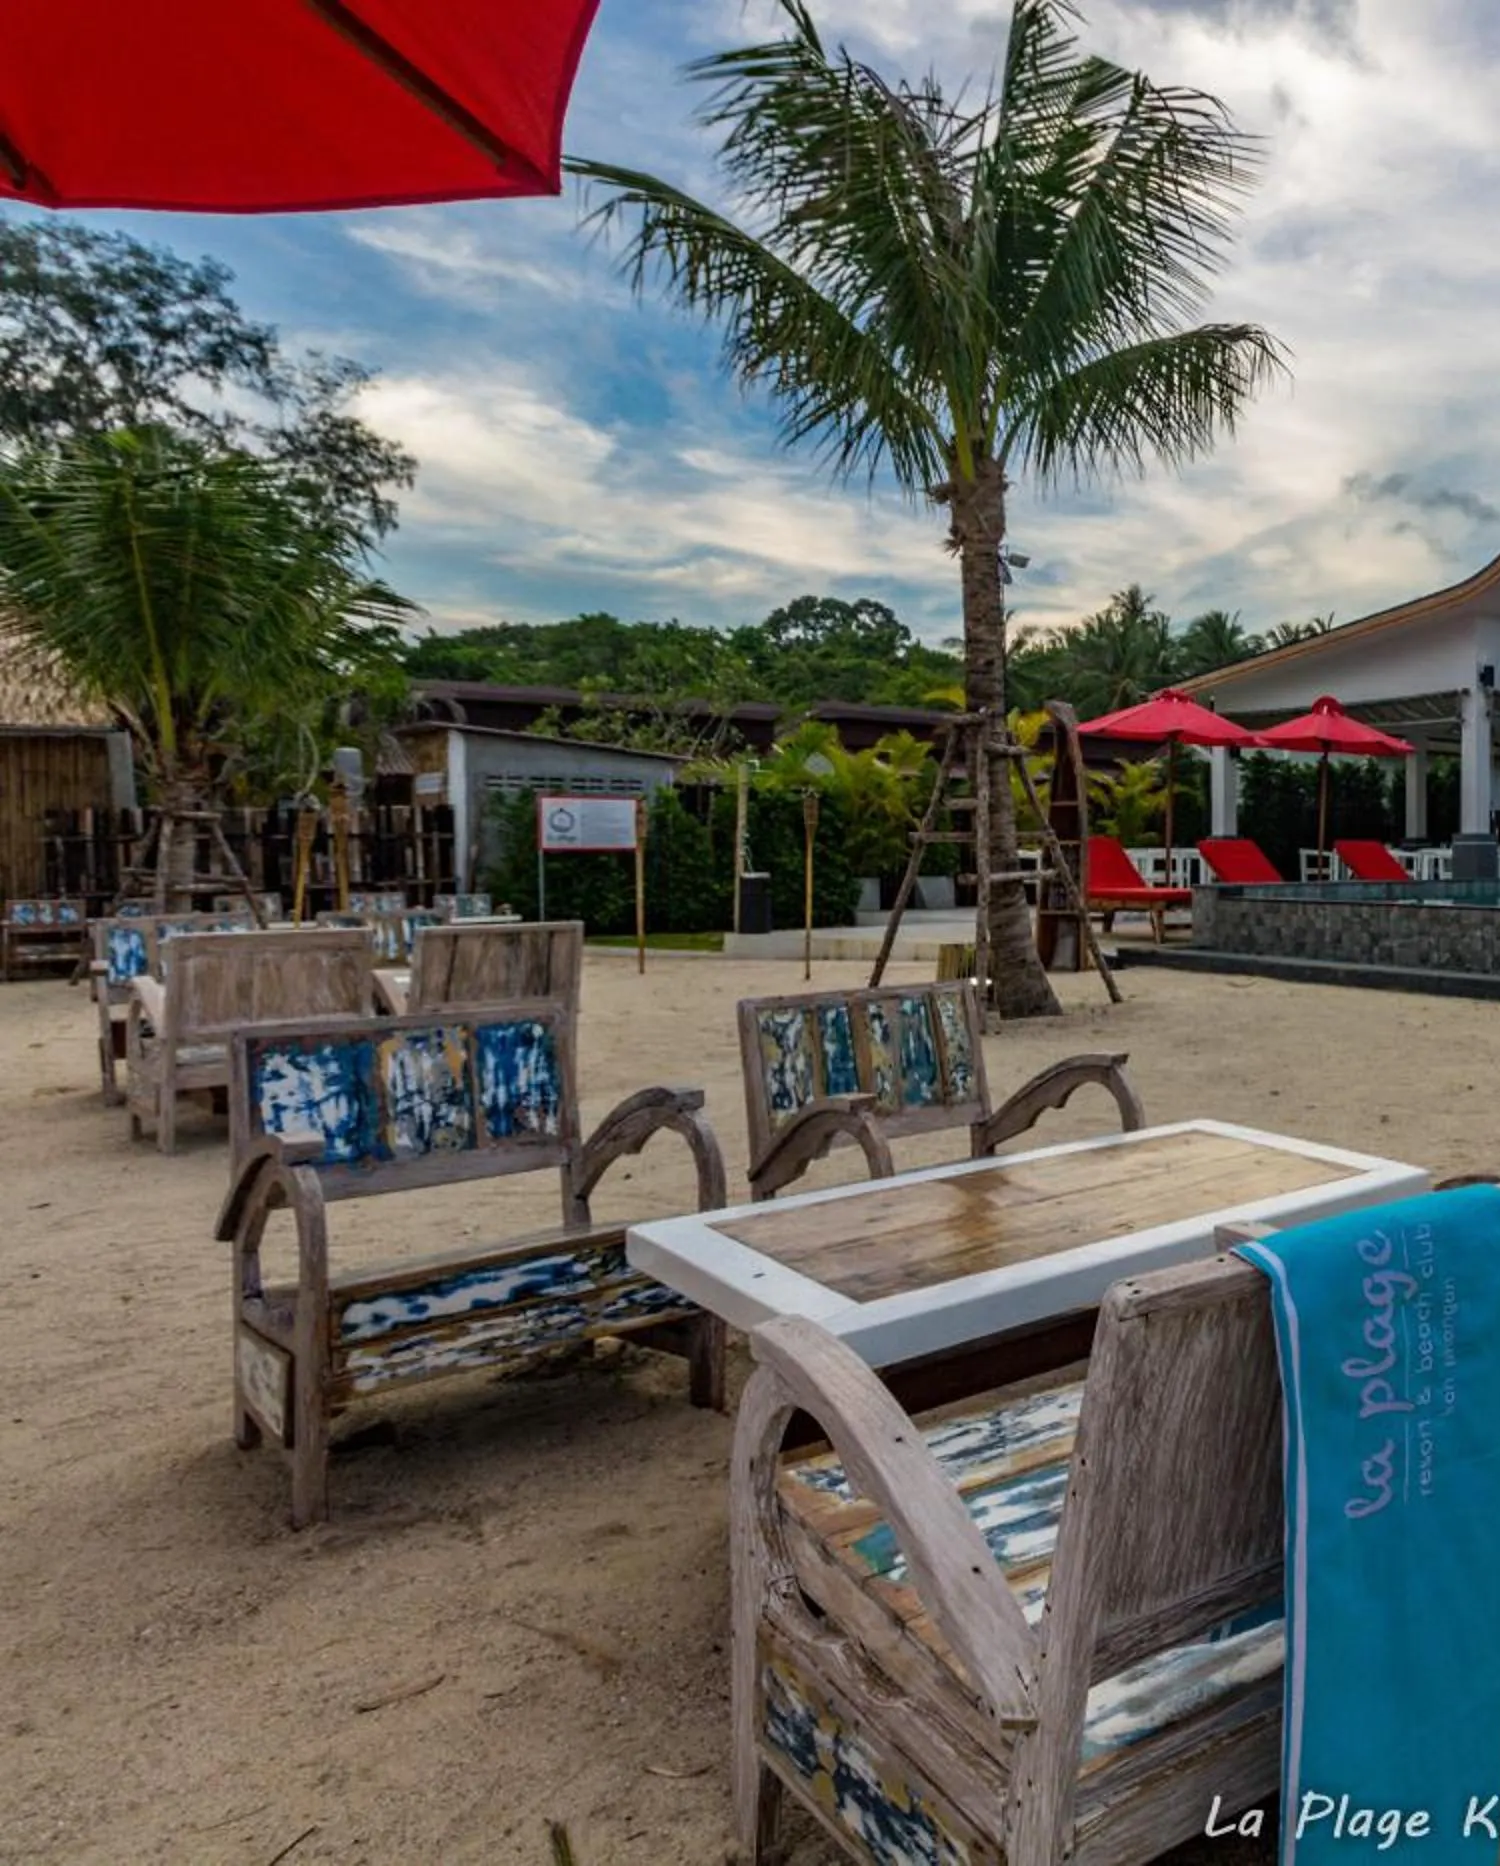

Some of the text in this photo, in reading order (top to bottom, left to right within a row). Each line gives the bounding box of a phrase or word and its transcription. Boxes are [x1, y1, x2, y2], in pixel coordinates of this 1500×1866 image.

[1415, 1222, 1433, 1280] club
[1341, 1229, 1416, 1518] la plage
[1416, 1291, 1434, 1374] beach
